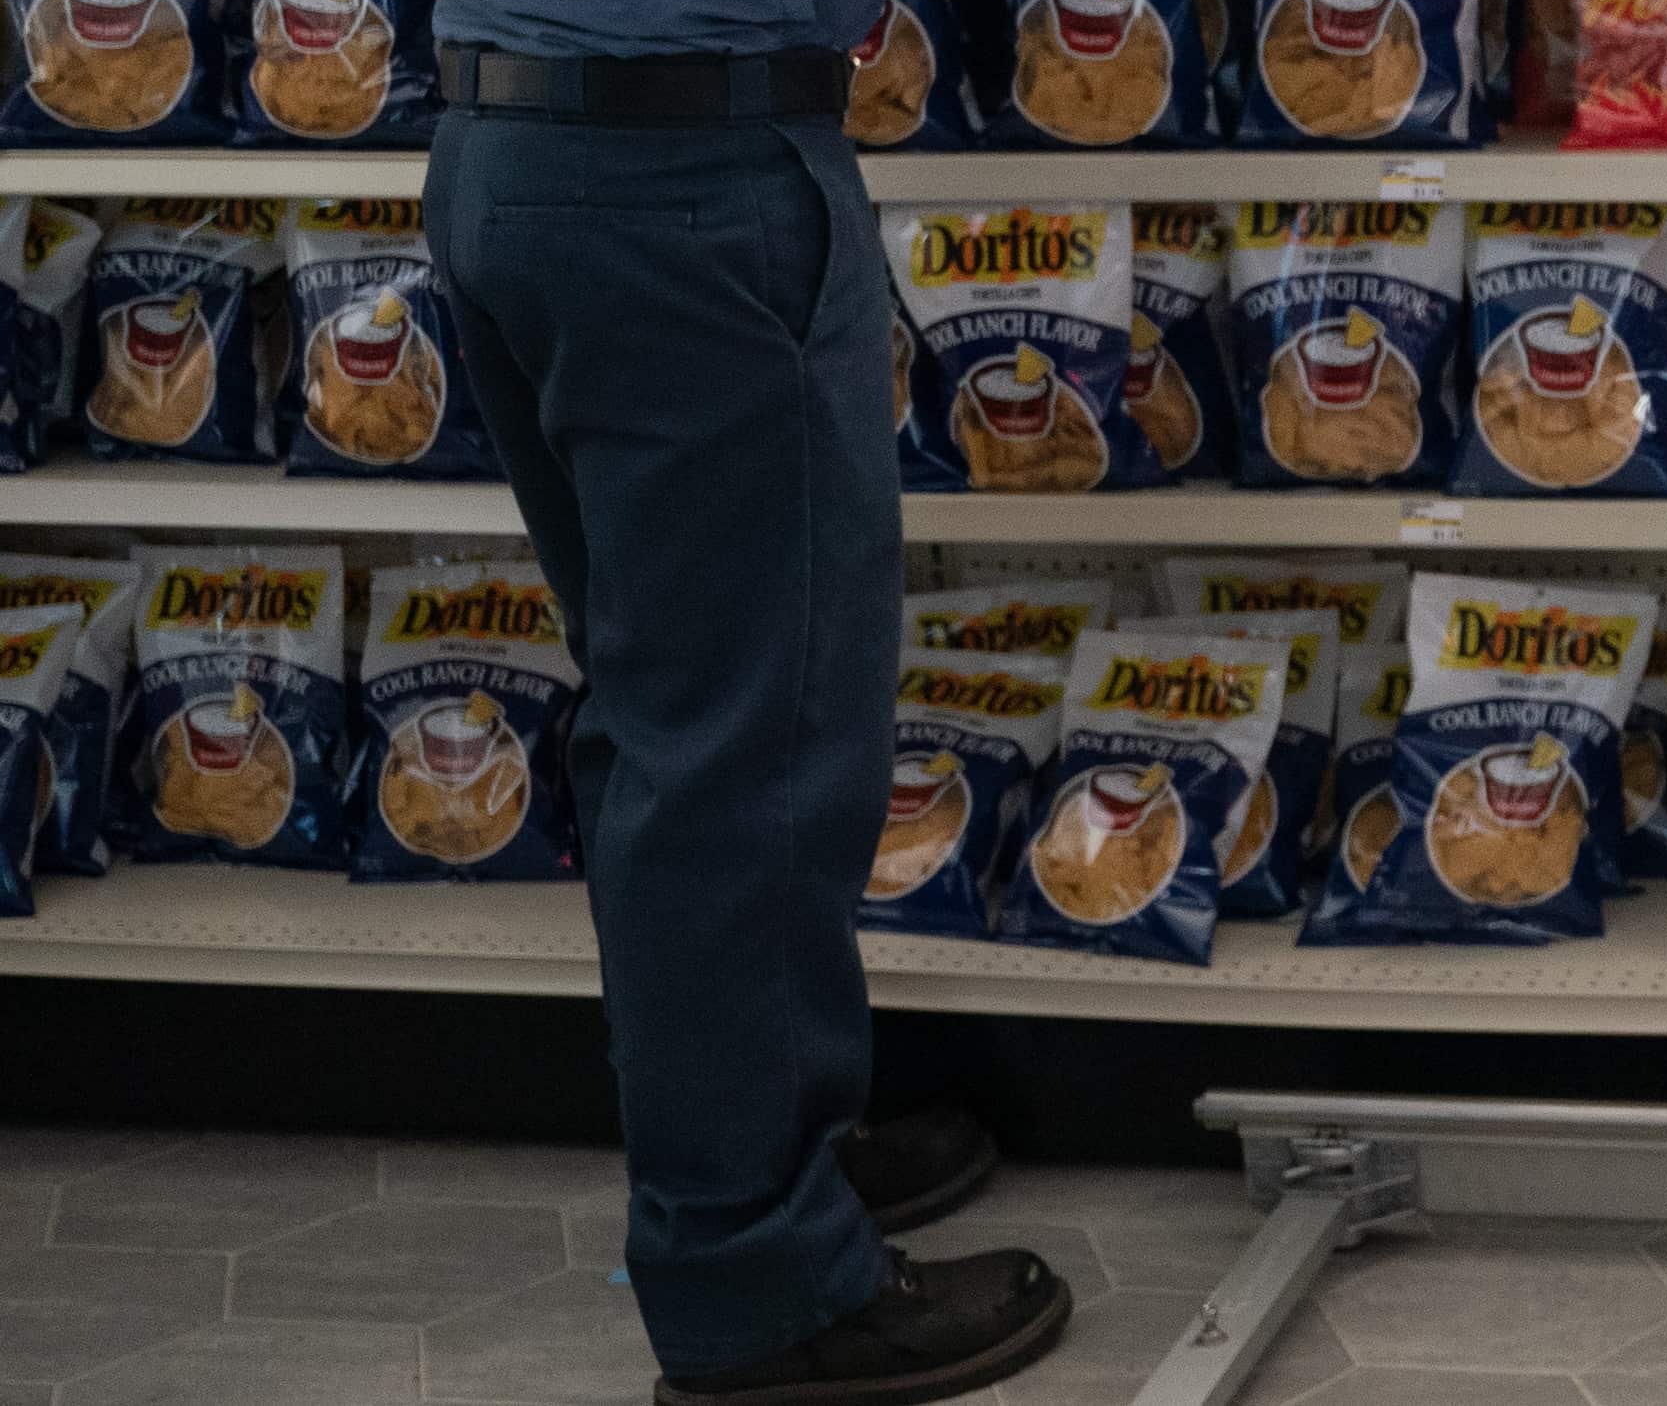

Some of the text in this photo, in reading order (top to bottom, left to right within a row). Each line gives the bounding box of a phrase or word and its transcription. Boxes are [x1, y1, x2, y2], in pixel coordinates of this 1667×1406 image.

[920, 216, 1096, 276] Doritos
[159, 568, 316, 627] Doritos
[402, 580, 561, 637] Doritos
[1456, 605, 1623, 670] Doritos
[1103, 658, 1257, 718] Doritos
